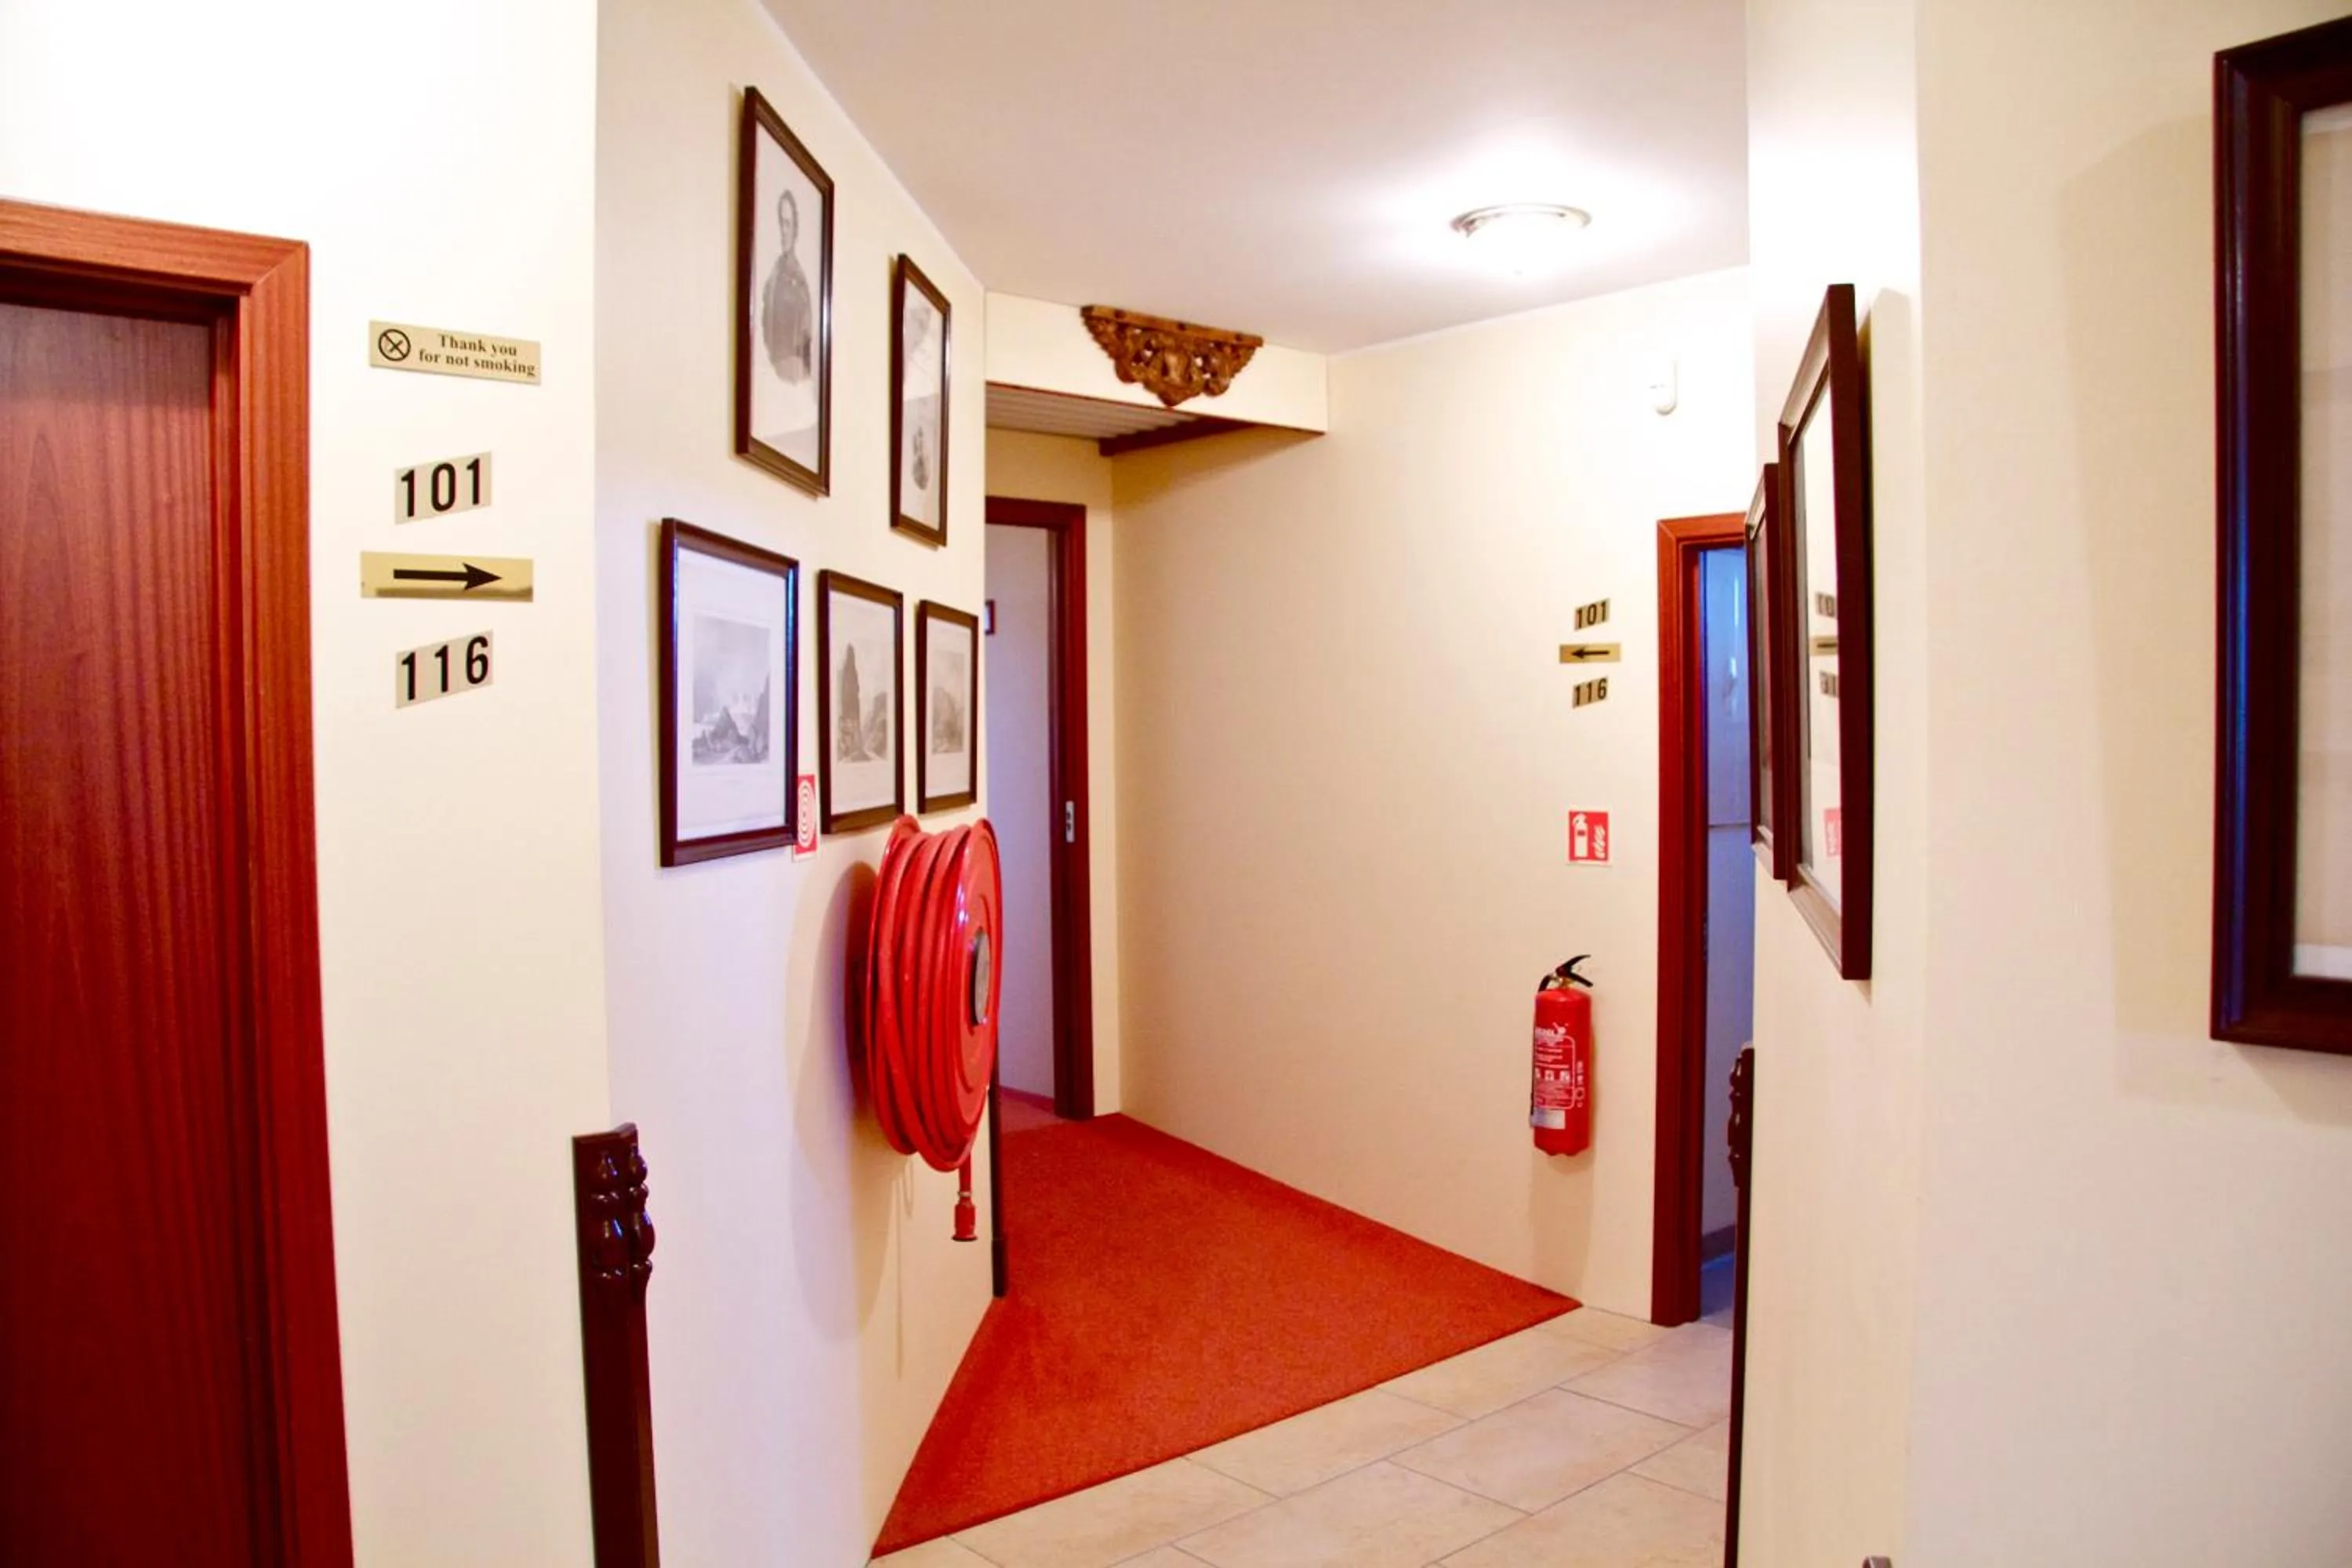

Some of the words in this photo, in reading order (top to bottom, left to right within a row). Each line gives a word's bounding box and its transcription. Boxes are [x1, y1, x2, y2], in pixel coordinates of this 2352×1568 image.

[438, 333, 487, 352] Thank
[491, 340, 517, 357] you
[419, 349, 441, 363] for
[445, 353, 470, 367] not
[474, 358, 536, 377] smoking
[400, 457, 481, 518] 101
[1576, 600, 1607, 629] 101
[401, 635, 490, 701] 116
[1575, 677, 1607, 706] 116
